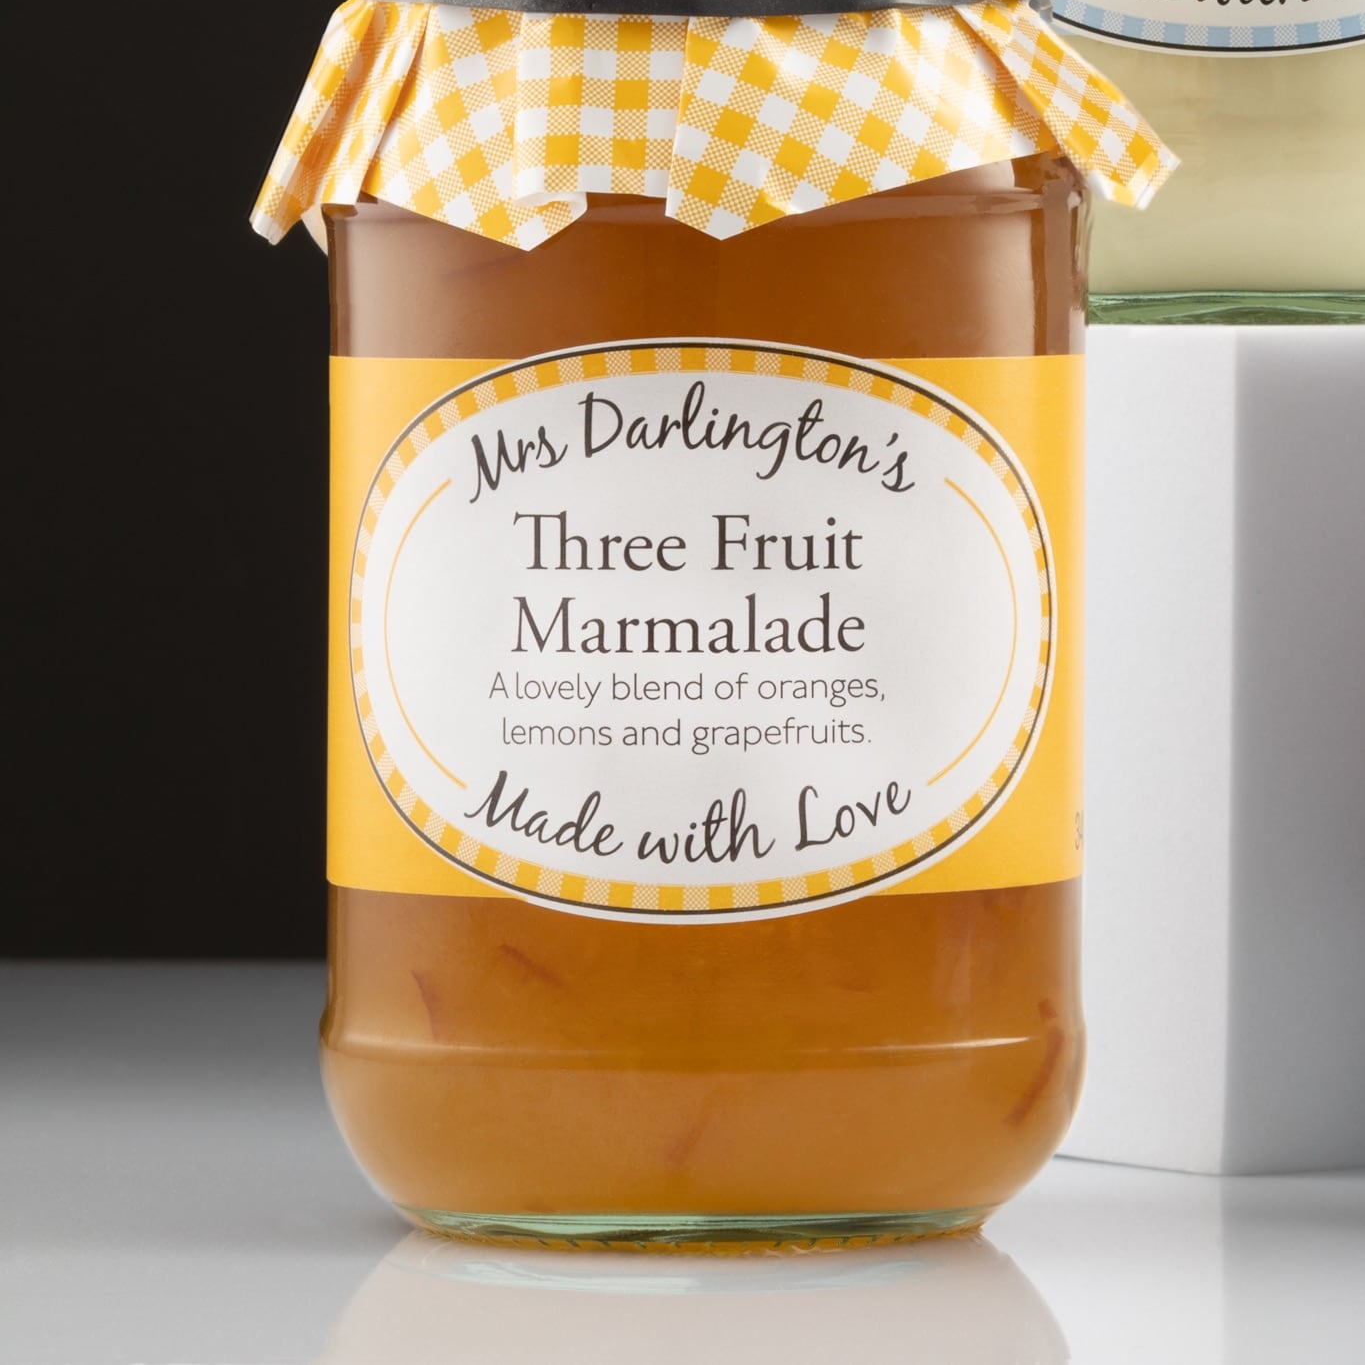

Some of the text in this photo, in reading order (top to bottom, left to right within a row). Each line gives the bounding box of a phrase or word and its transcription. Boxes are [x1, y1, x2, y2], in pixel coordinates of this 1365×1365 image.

[469, 380, 915, 504] Mrs Darlington's
[513, 510, 863, 572] Three Fruit
[511, 591, 865, 654] Marmalade
[488, 671, 885, 709] A lovely blend of oranges,
[502, 716, 873, 756] lemons and grapefruits.
[463, 770, 912, 865] Made with Love
